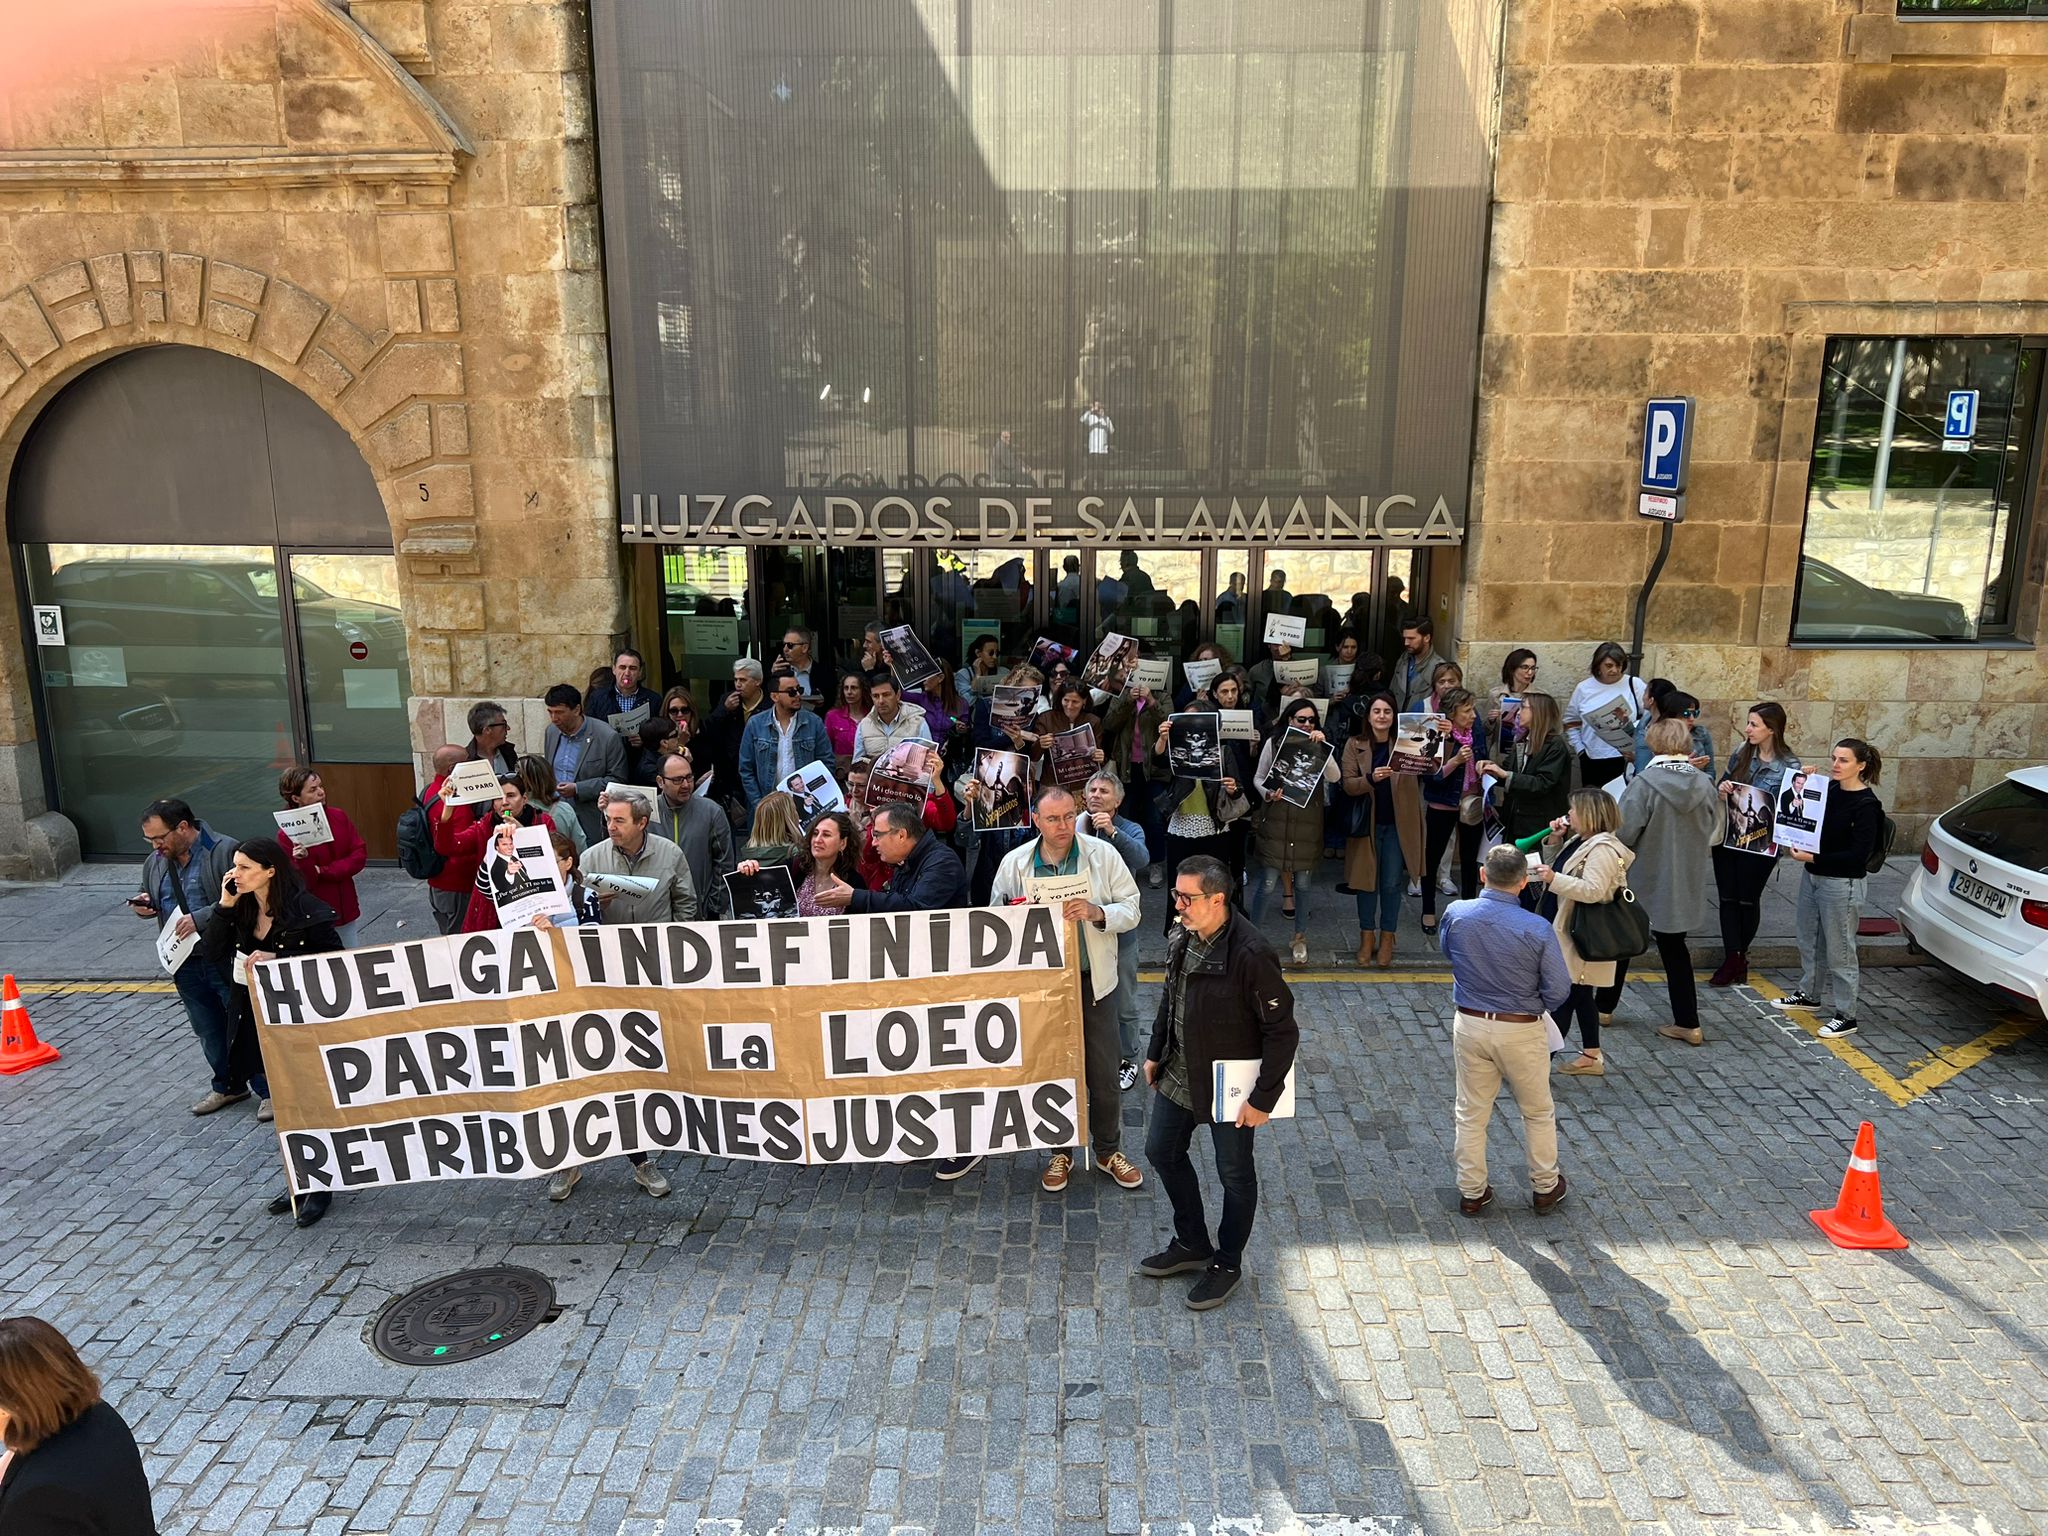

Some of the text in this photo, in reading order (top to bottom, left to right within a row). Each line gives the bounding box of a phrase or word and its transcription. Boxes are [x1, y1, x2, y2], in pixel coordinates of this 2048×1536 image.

[1648, 410, 1676, 479] P
[419, 483, 430, 502] 5
[622, 494, 1461, 543] JUZGADOS DE SALAMANCA
[475, 782, 494, 790] PARO
[872, 784, 922, 802] Mi destino lo
[497, 890, 508, 901] ¿Por
[508, 887, 519, 895] qué
[609, 882, 620, 892] YO
[621, 888, 642, 899] PARO
[1064, 889, 1088, 898] PARO
[1955, 876, 2007, 913] 2918 HPM
[256, 930, 557, 1024] HUELGA
[326, 1002, 1017, 1105] PAREMOS La LOEO
[812, 1083, 1076, 1162] JUSTAS
